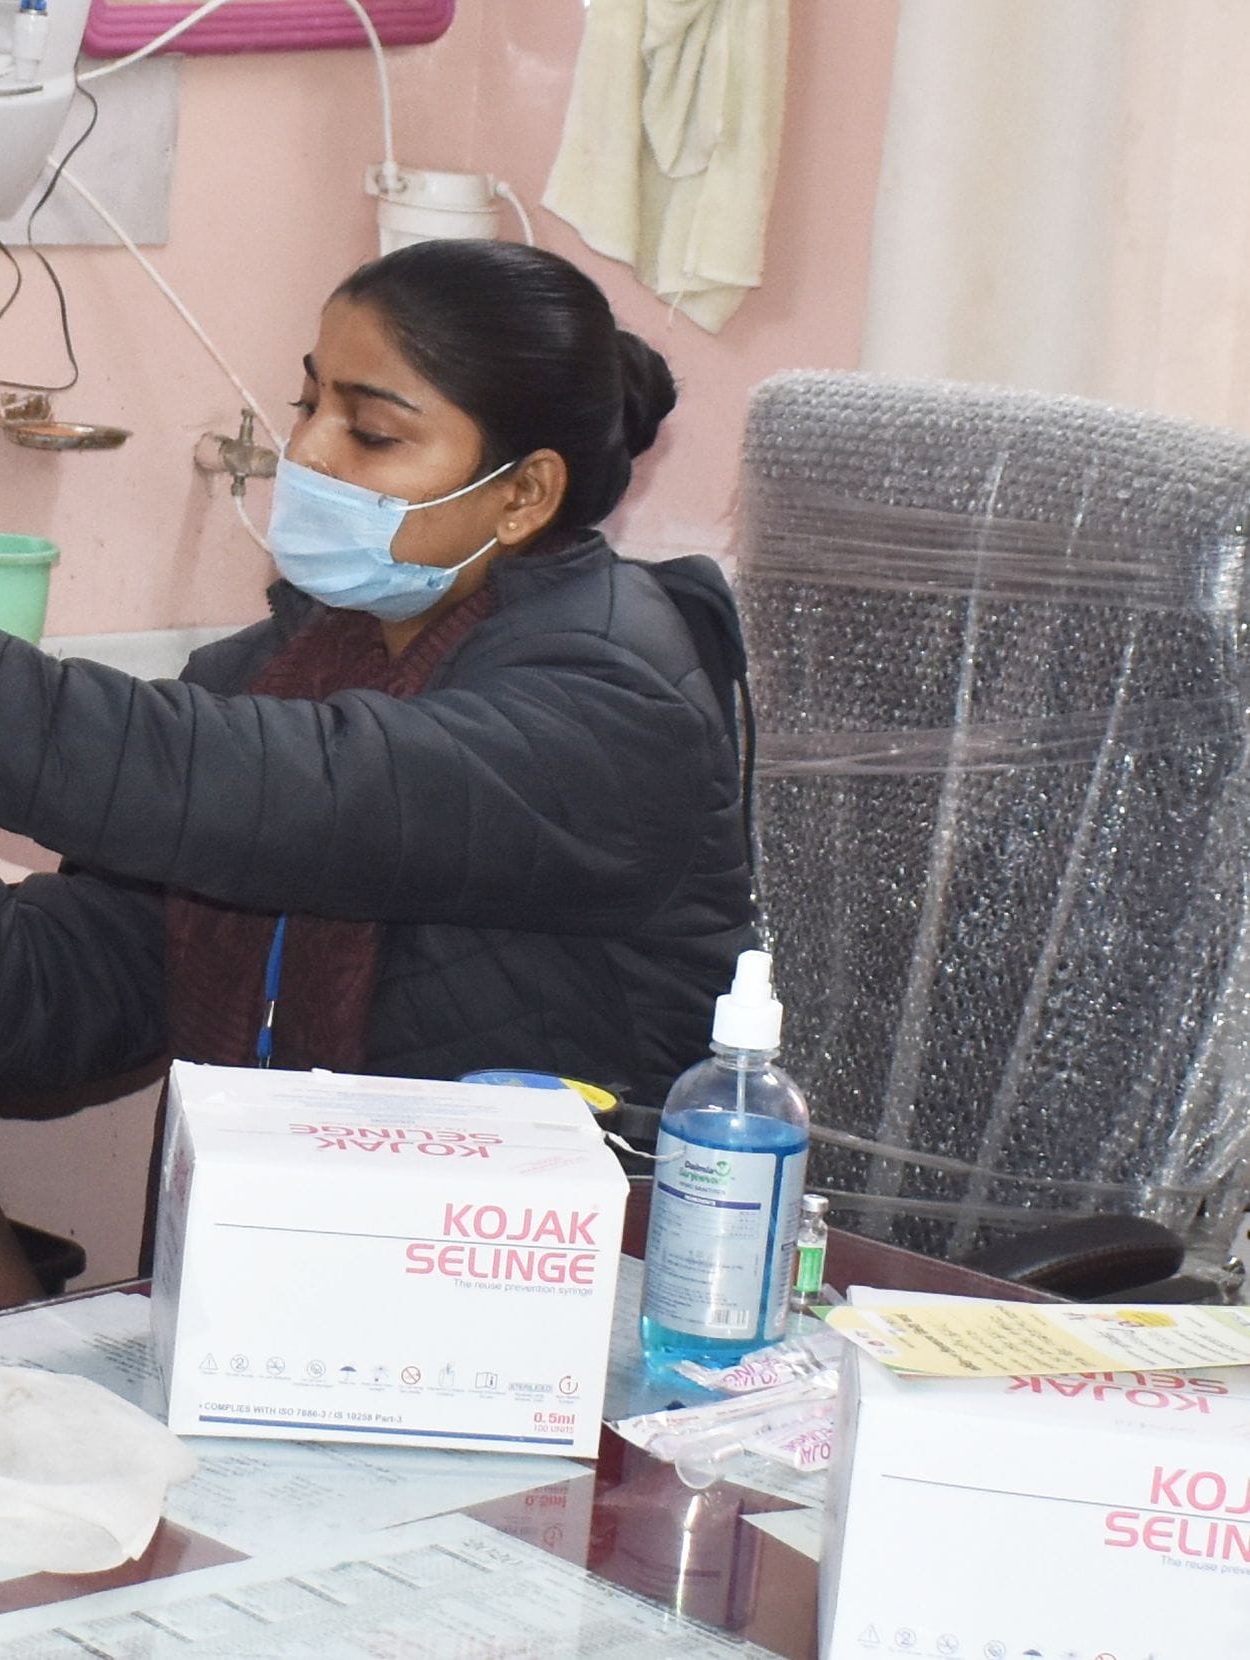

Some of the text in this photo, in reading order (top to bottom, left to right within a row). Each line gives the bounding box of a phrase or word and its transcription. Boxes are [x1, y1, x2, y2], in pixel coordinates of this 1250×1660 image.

[289, 1123, 503, 1144] SELINGE
[317, 1136, 490, 1158] KOJAK
[443, 1202, 599, 1245] KOJAK
[405, 1243, 596, 1285] SELINGE
[453, 1278, 594, 1297] The reuse prevention syringe
[1058, 1371, 1229, 1395] SELI
[204, 1401, 251, 1413] COMPLIES
[253, 1405, 276, 1414] WITH
[1150, 1466, 1250, 1514] KOJ
[1104, 1510, 1250, 1562] SELIN
[1161, 1555, 1181, 1567] The
